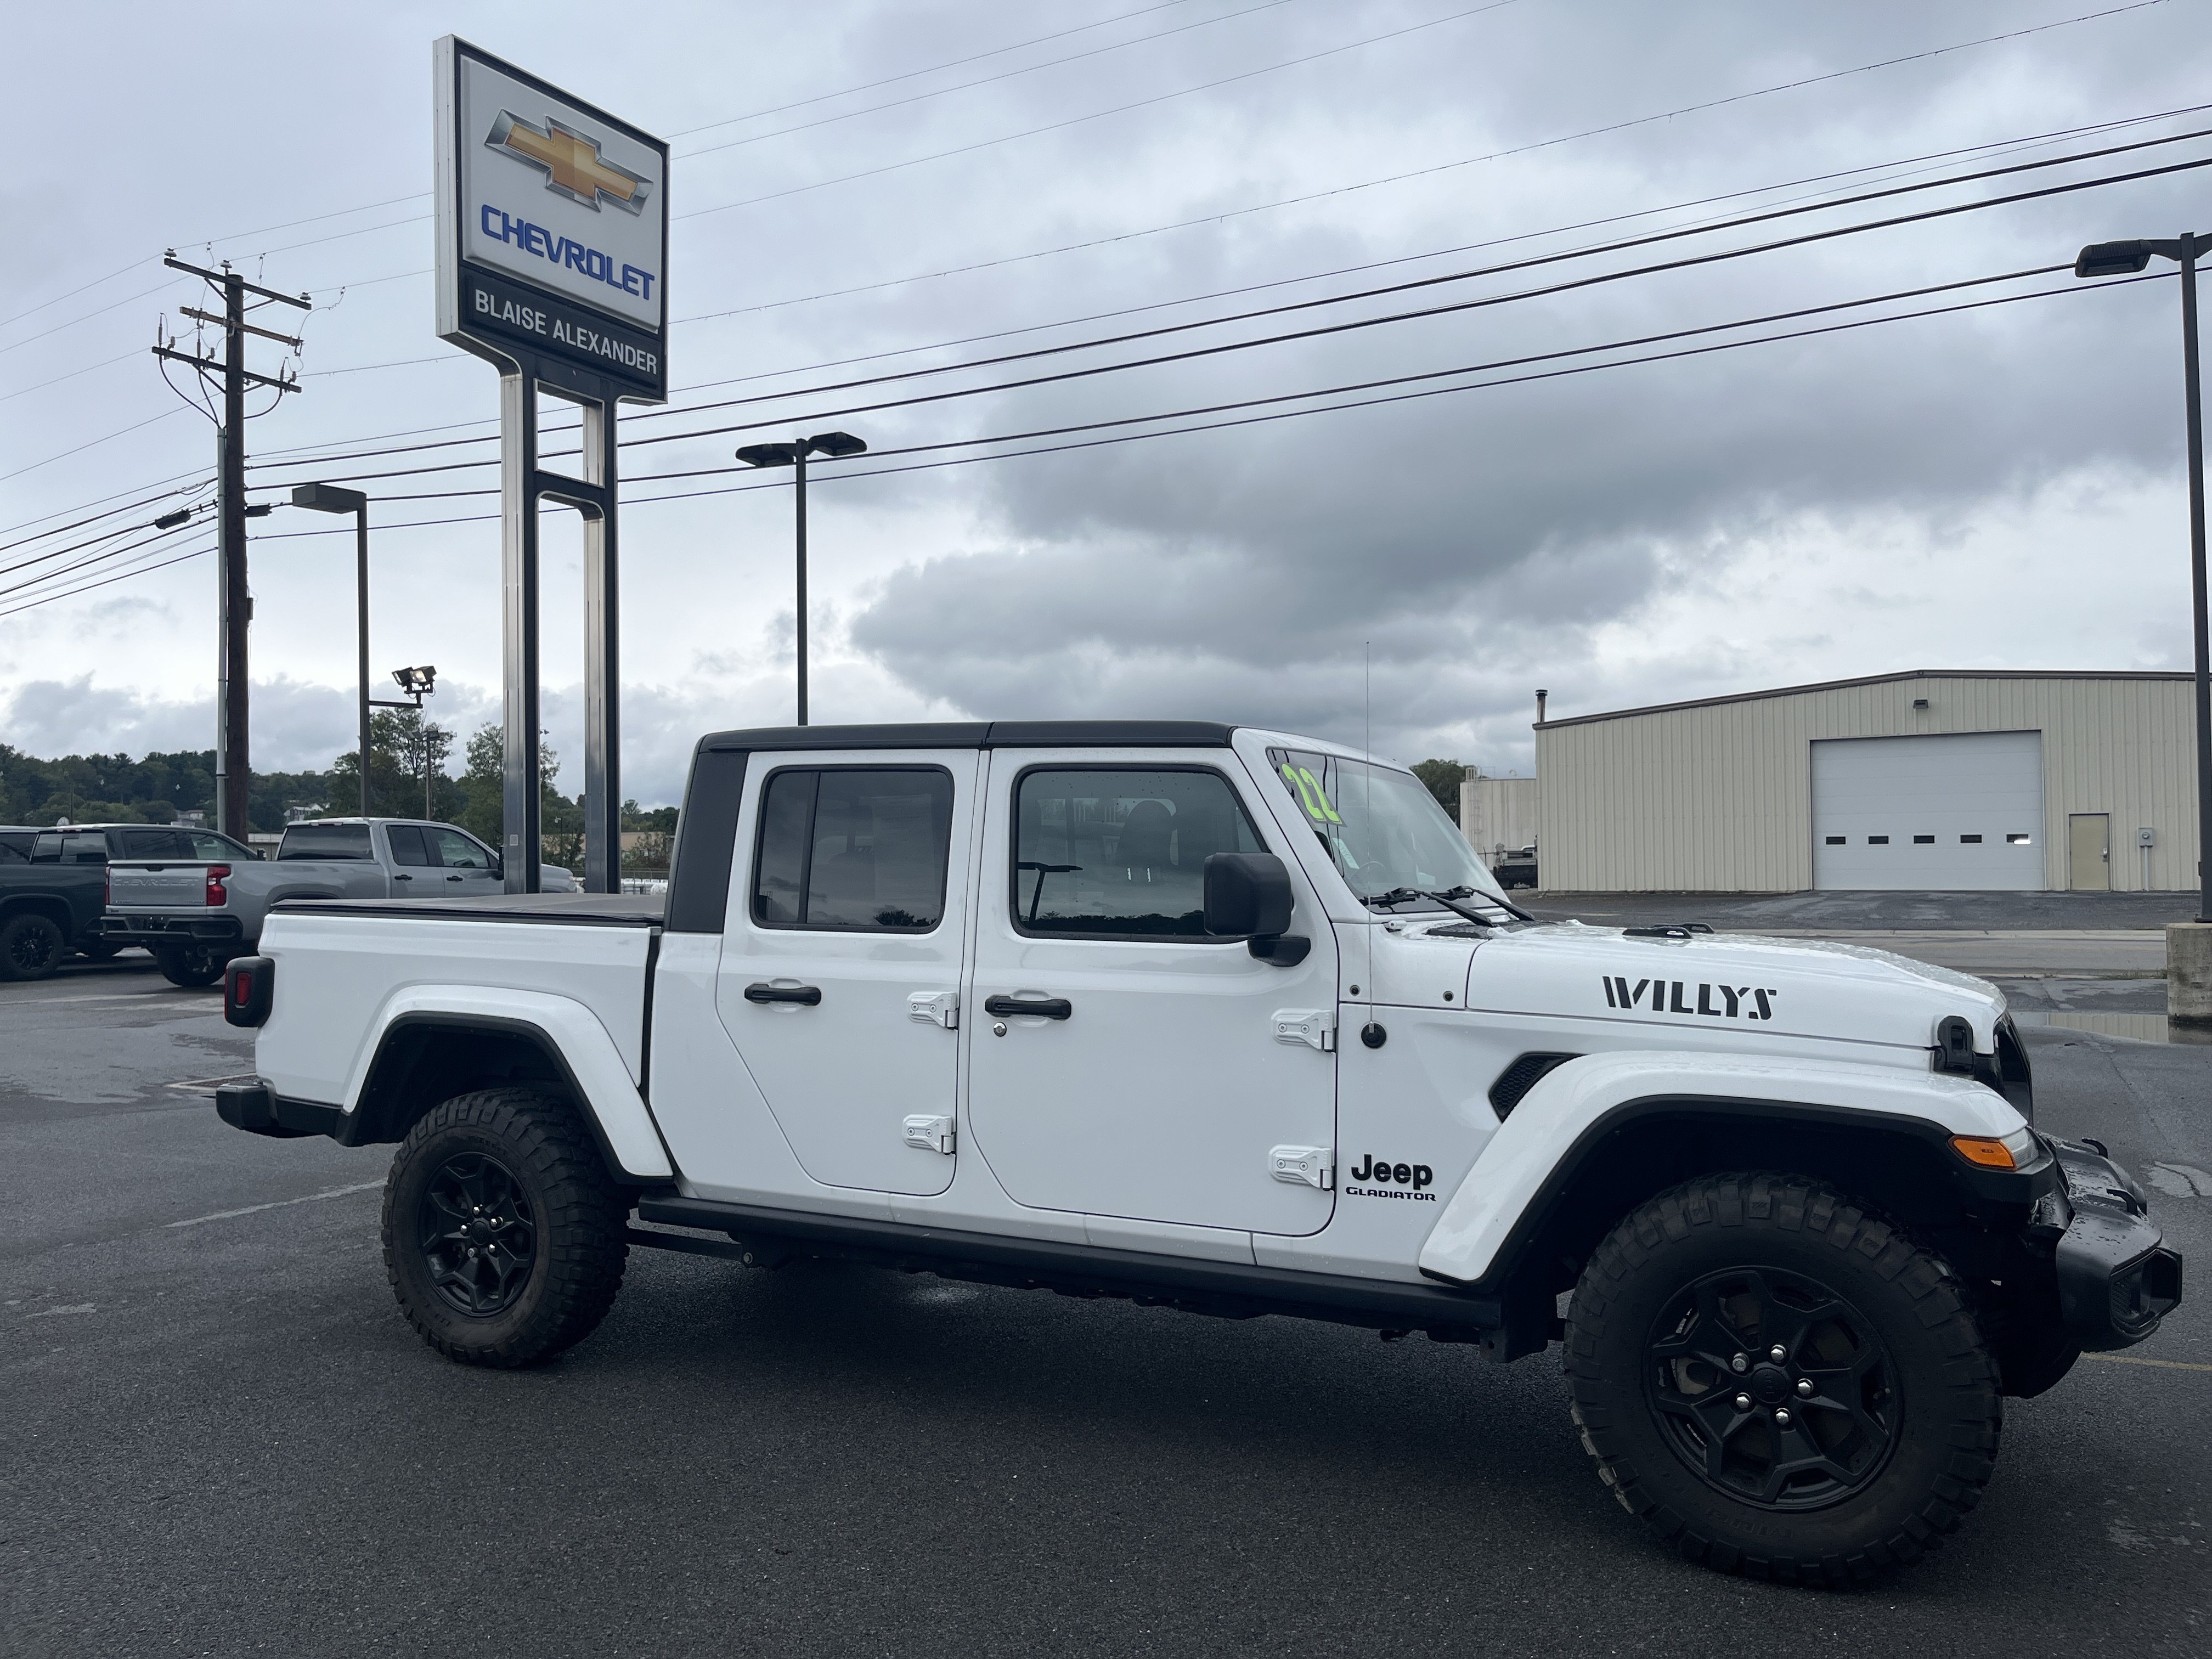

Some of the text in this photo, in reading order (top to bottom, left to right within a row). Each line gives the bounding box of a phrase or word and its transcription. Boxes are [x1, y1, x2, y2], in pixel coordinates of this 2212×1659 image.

[482, 204, 655, 300] CHEVROLET
[475, 289, 657, 375] BLAISE ALEXANDER
[1282, 764, 1342, 825] 22
[1602, 975, 1778, 1020] WILLYS
[1346, 1186, 1436, 1201] GLADIATOR
[1351, 1154, 1432, 1190] Jeep
